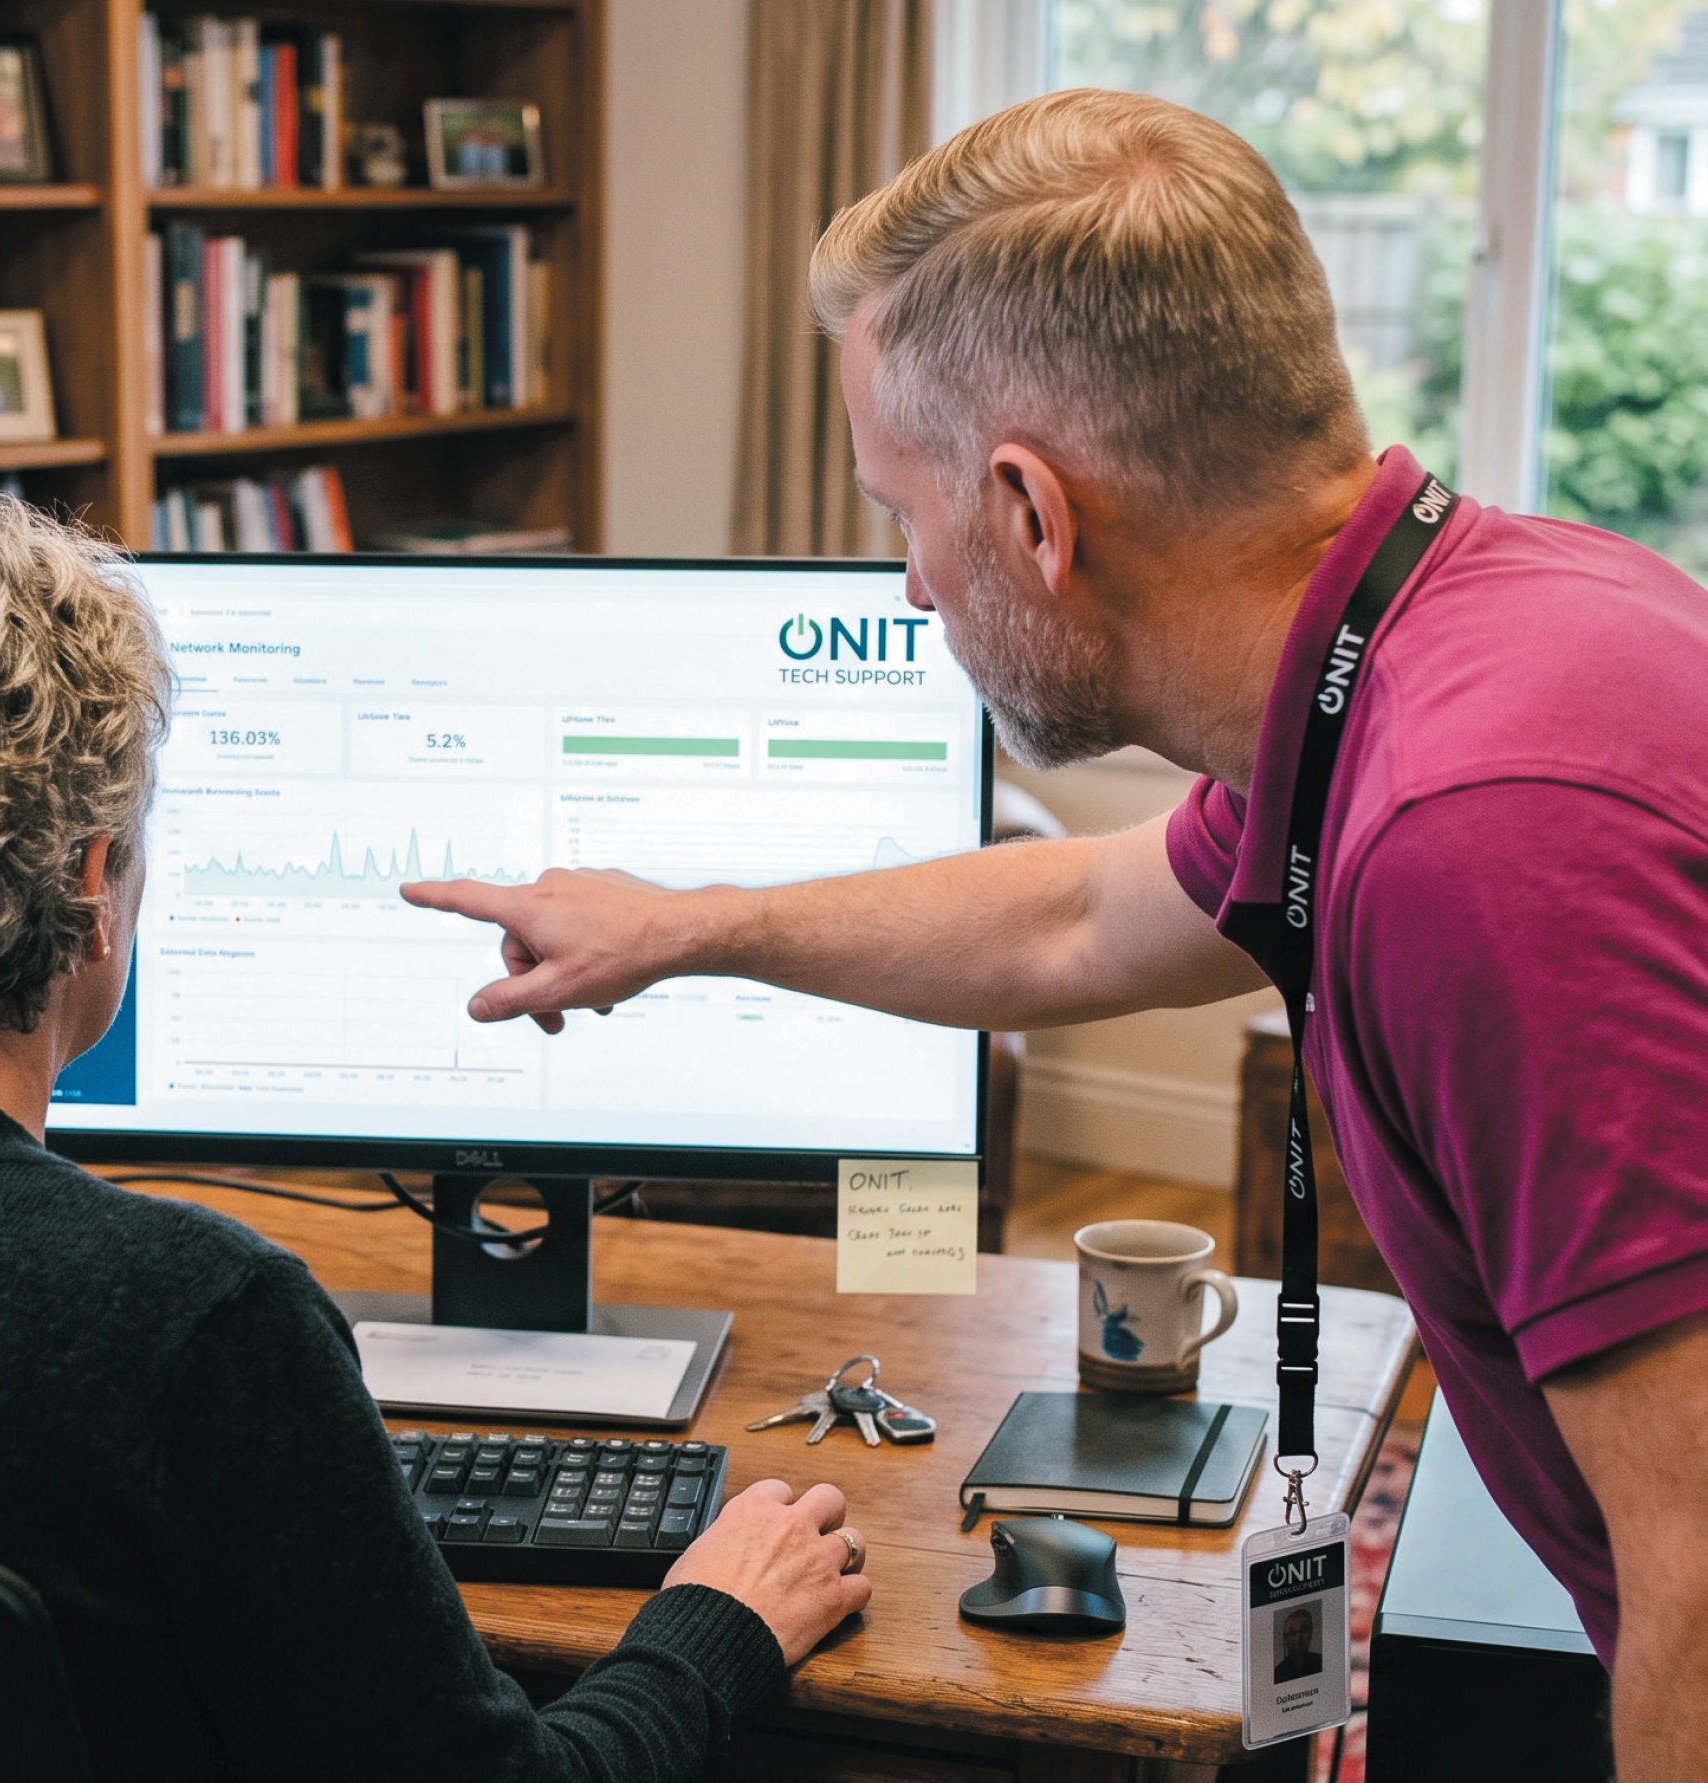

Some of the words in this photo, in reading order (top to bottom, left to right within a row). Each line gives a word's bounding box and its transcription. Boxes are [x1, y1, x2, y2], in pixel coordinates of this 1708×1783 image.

[1412, 478, 1453, 524] ONIT
[170, 642, 224, 654] Network
[228, 642, 301, 658] Monitoring
[779, 613, 929, 662] ONIT
[778, 668, 829, 684] TECH
[835, 669, 926, 686] SUPPORT
[1317, 624, 1365, 714] ONIT
[426, 733, 466, 749] 5.2%
[1286, 845, 1311, 928] ONIT
[456, 1150, 503, 1168] DELL
[1288, 1117, 1305, 1199] ONIT
[1268, 1555, 1327, 1587] ONIT
